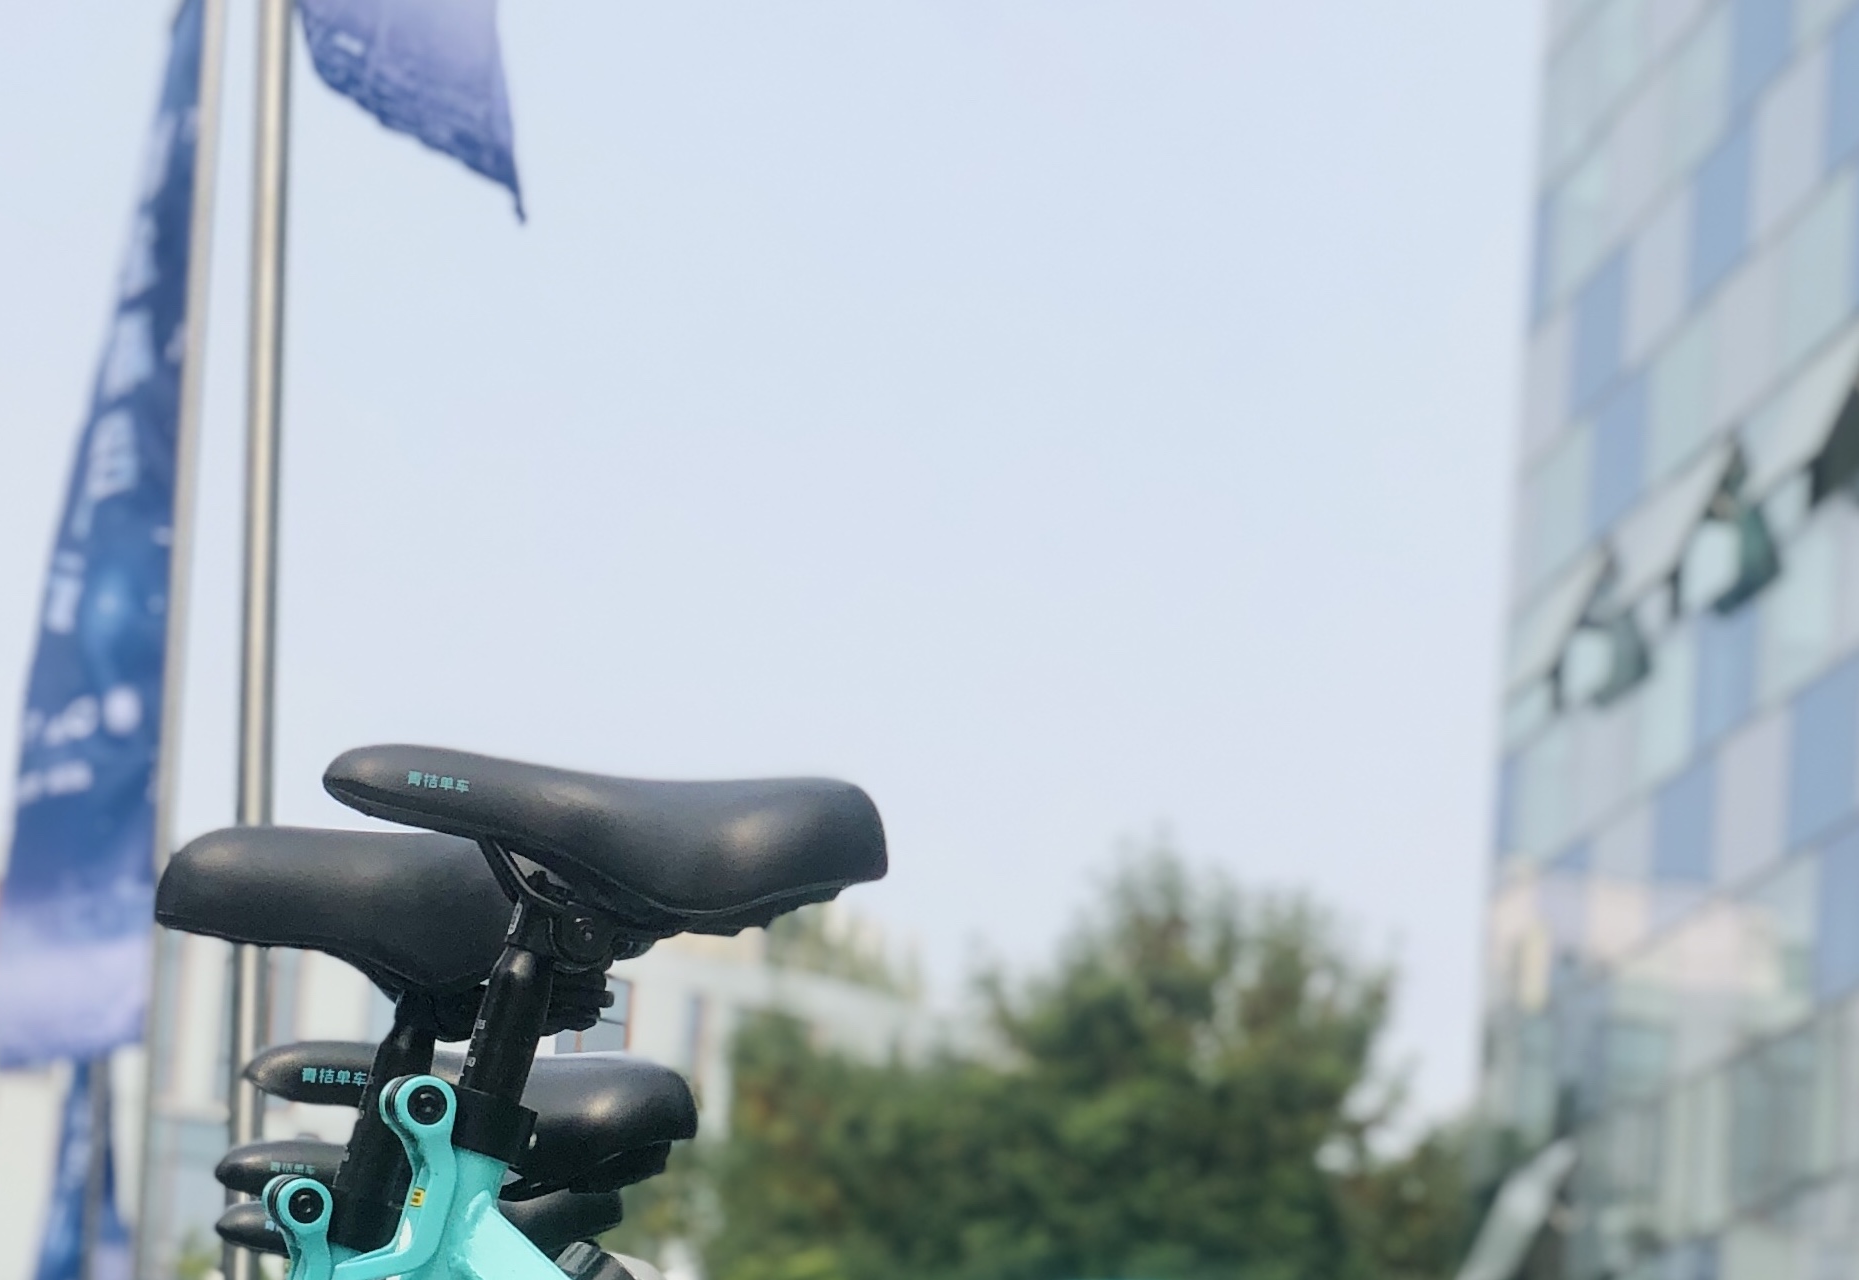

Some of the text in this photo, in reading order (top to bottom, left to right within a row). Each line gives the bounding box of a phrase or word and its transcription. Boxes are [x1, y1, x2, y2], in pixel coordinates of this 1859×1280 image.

[407, 770, 471, 793] 青桔单车
[301, 1067, 368, 1086] 青桔单车
